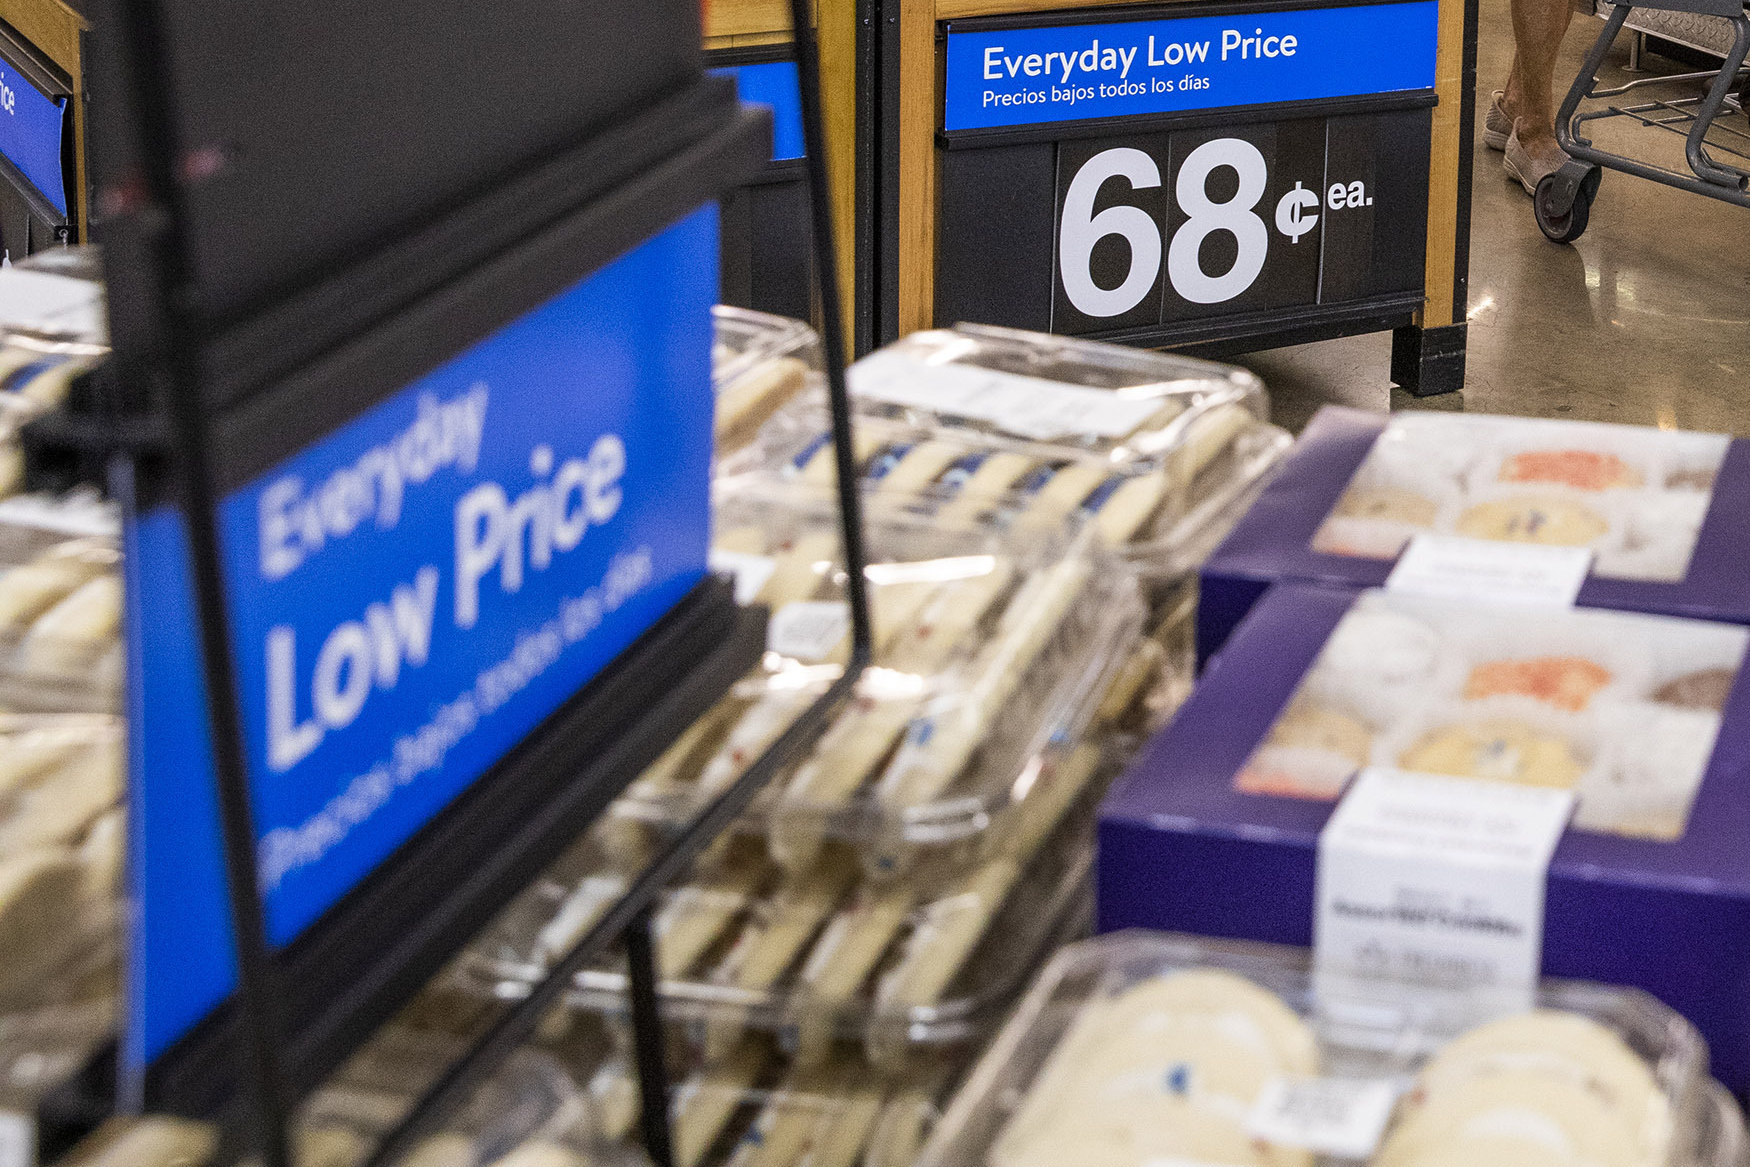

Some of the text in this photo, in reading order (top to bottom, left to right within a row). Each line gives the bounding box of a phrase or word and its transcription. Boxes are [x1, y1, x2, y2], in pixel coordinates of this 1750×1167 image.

[982, 74, 1211, 108] Precios bajos todos los días
[983, 27, 1298, 84] Everyday Low Price
[1059, 137, 1374, 319] 68¢ ea.
[257, 379, 491, 581] Everyday
[264, 432, 626, 774] Low Price
